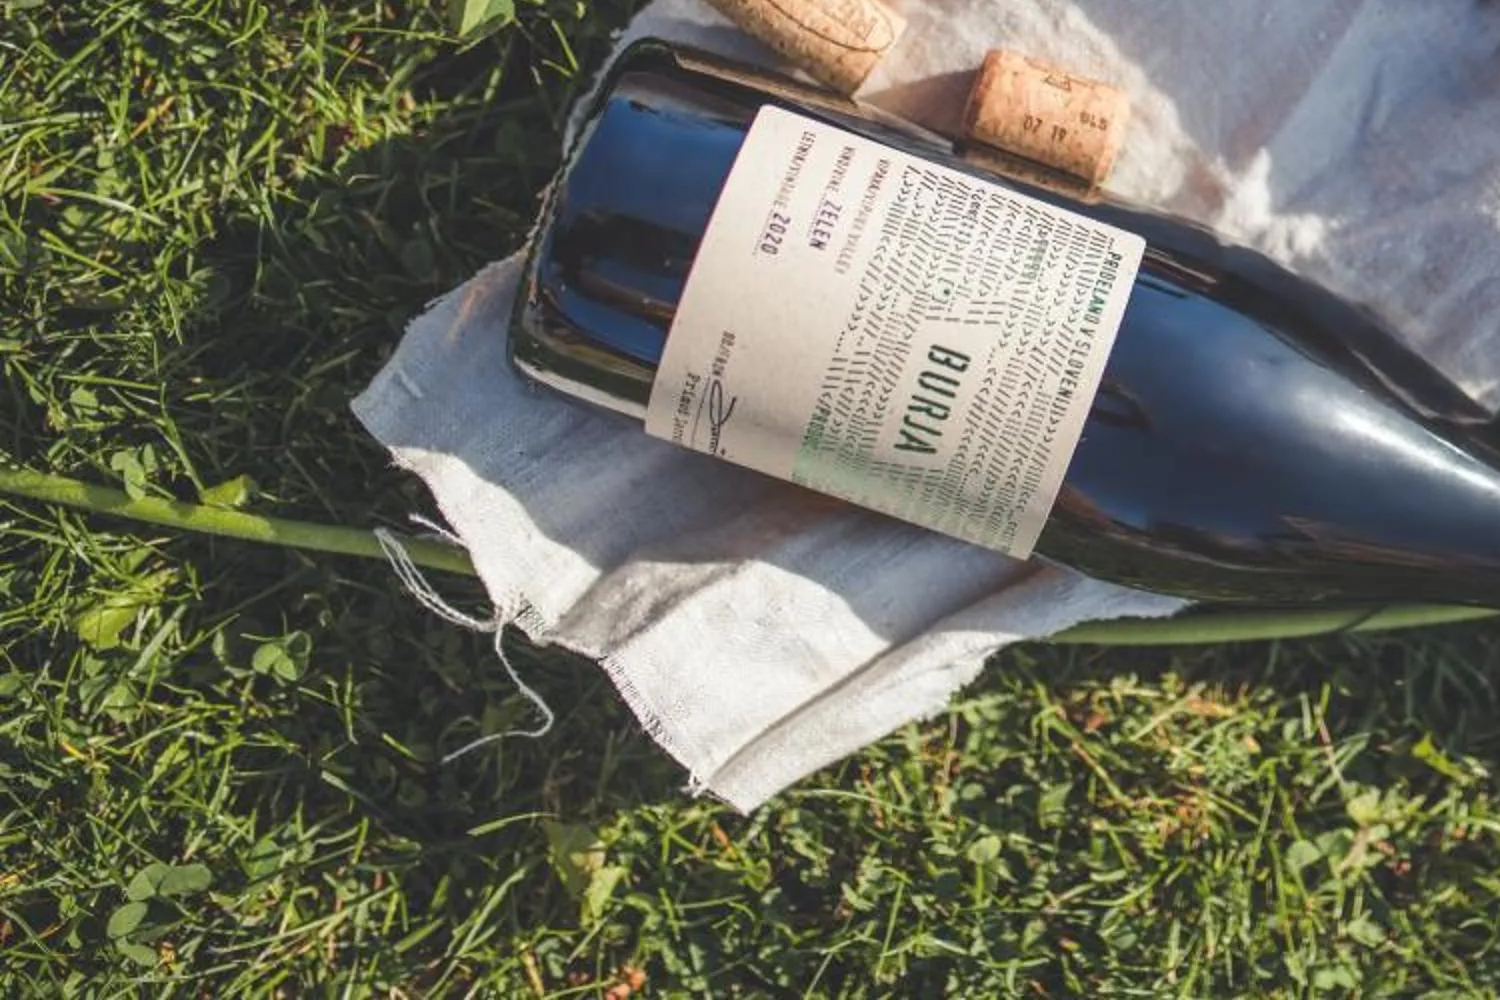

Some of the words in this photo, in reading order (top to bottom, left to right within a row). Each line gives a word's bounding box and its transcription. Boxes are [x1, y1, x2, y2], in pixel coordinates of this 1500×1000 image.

[759, 211, 791, 256] 2020
[807, 199, 842, 252] ZELEN
[1083, 251, 1123, 326] PRIDELANO
[1078, 325, 1096, 339] V
[892, 344, 971, 452] BURJA
